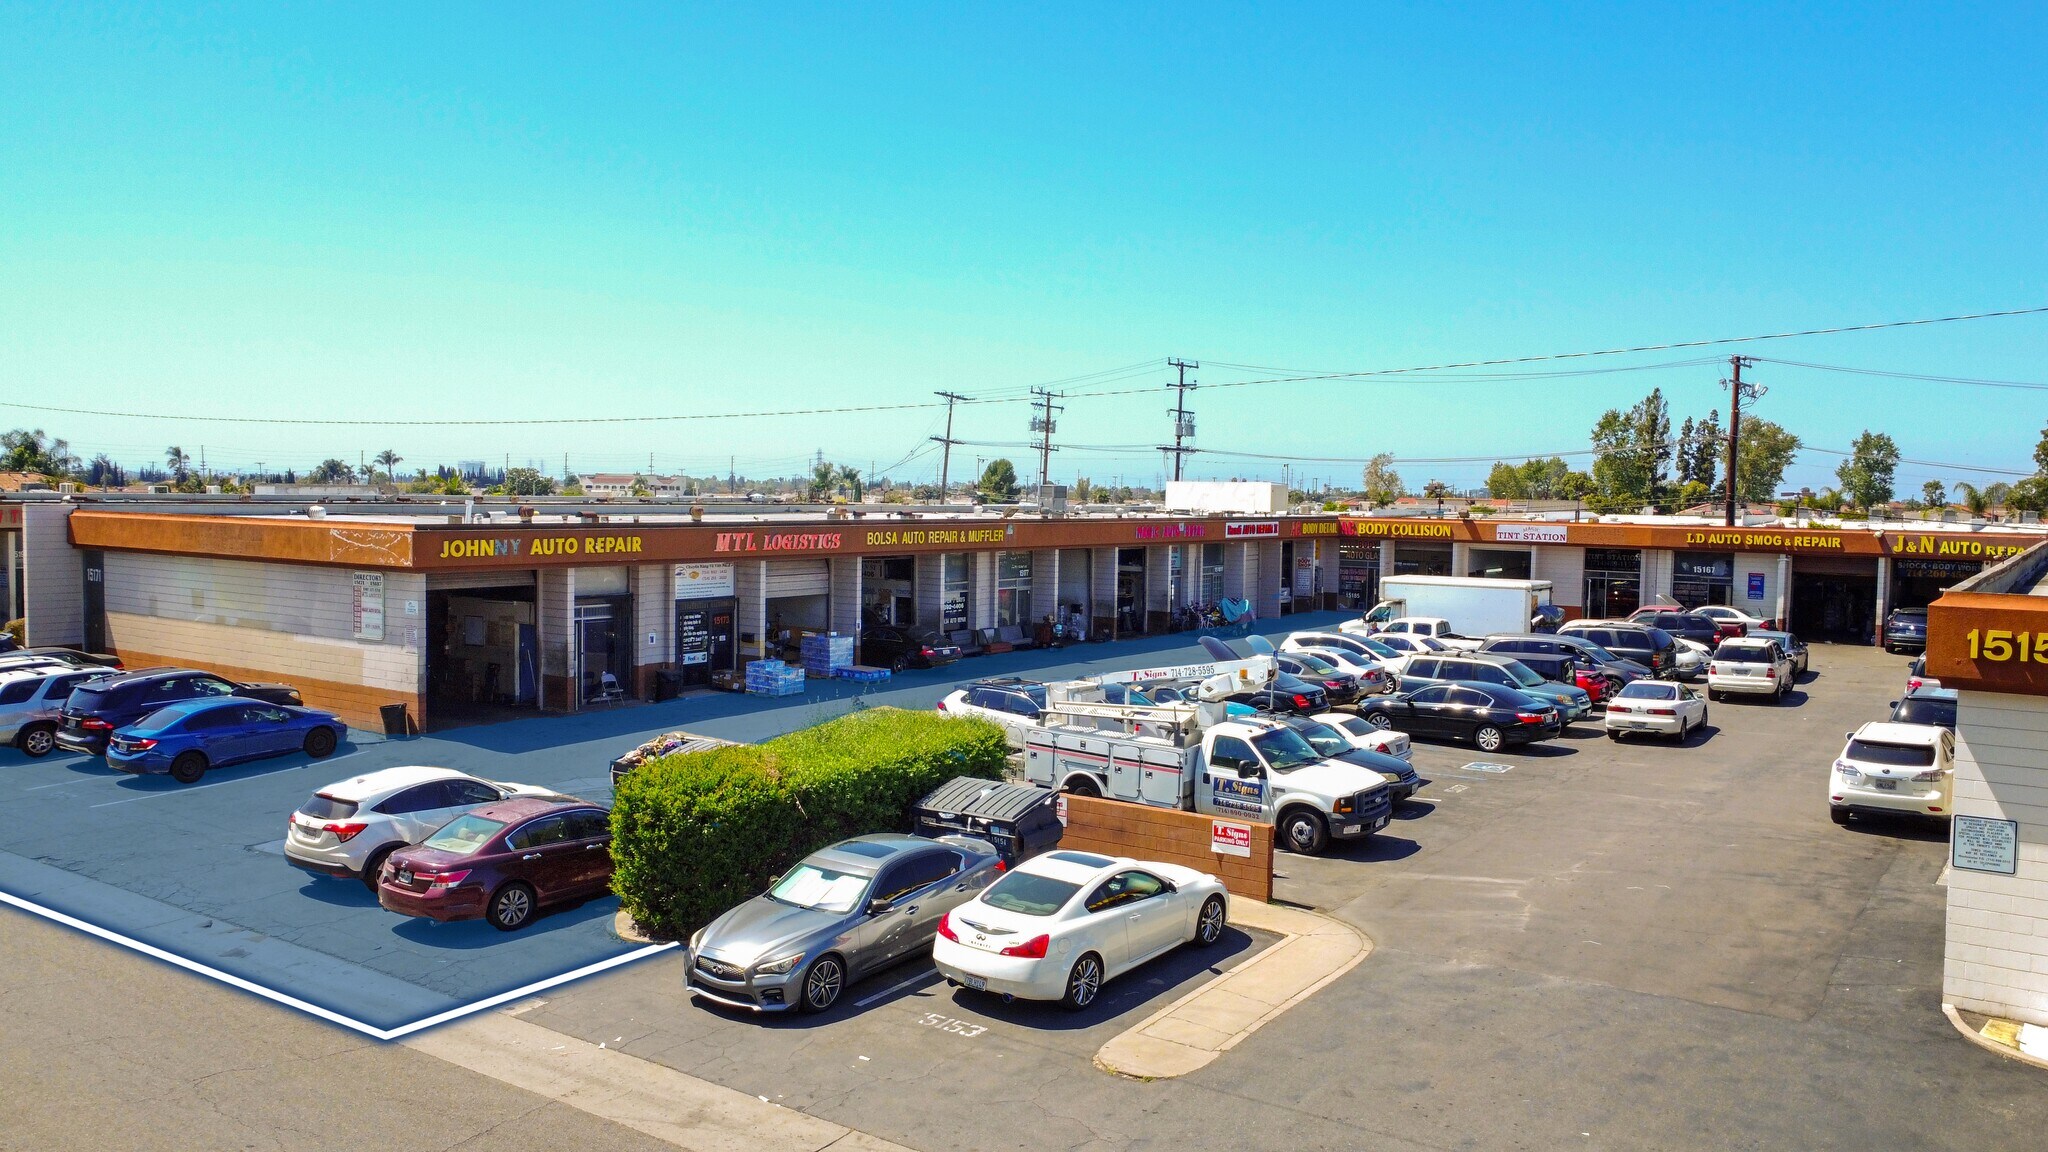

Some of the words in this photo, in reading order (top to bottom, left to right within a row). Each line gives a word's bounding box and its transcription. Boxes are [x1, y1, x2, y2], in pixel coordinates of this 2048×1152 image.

[1302, 522, 1318, 534] BODY
[1358, 522, 1389, 535] BODY
[1392, 524, 1451, 536] COLLISION
[714, 532, 757, 552] MTL
[762, 533, 841, 551] LOGISTICS
[866, 532, 898, 545] BOLSA
[902, 531, 925, 544] AUTO
[928, 530, 958, 544] REPAIR
[960, 531, 965, 543] &
[968, 530, 1004, 542] MUFFLER
[1523, 533, 1566, 542] STATION
[1708, 534, 1741, 544] AUTO
[1746, 535, 1782, 546] SMOG
[1794, 536, 1841, 548] REPAIR
[440, 539, 522, 558] JOHNNY
[530, 538, 578, 555] AUTO
[585, 537, 642, 554] REPAIR
[1893, 535, 1935, 554] J&N
[1940, 541, 1982, 554] AUTO
[1986, 546, 2025, 556] REPA
[87, 568, 101, 582] 15171
[1131, 672, 1142, 681] T.
[1144, 670, 1167, 679] Signs
[1171, 665, 1215, 677] 714-728-5595
[1217, 778, 1230, 792] T.
[1232, 780, 1259, 795] Signs
[1216, 799, 1260, 811] 714-728-5595
[1214, 836, 1235, 844] PARKING
[1226, 828, 1248, 839] Signs
[918, 1012, 988, 1037] 5153
